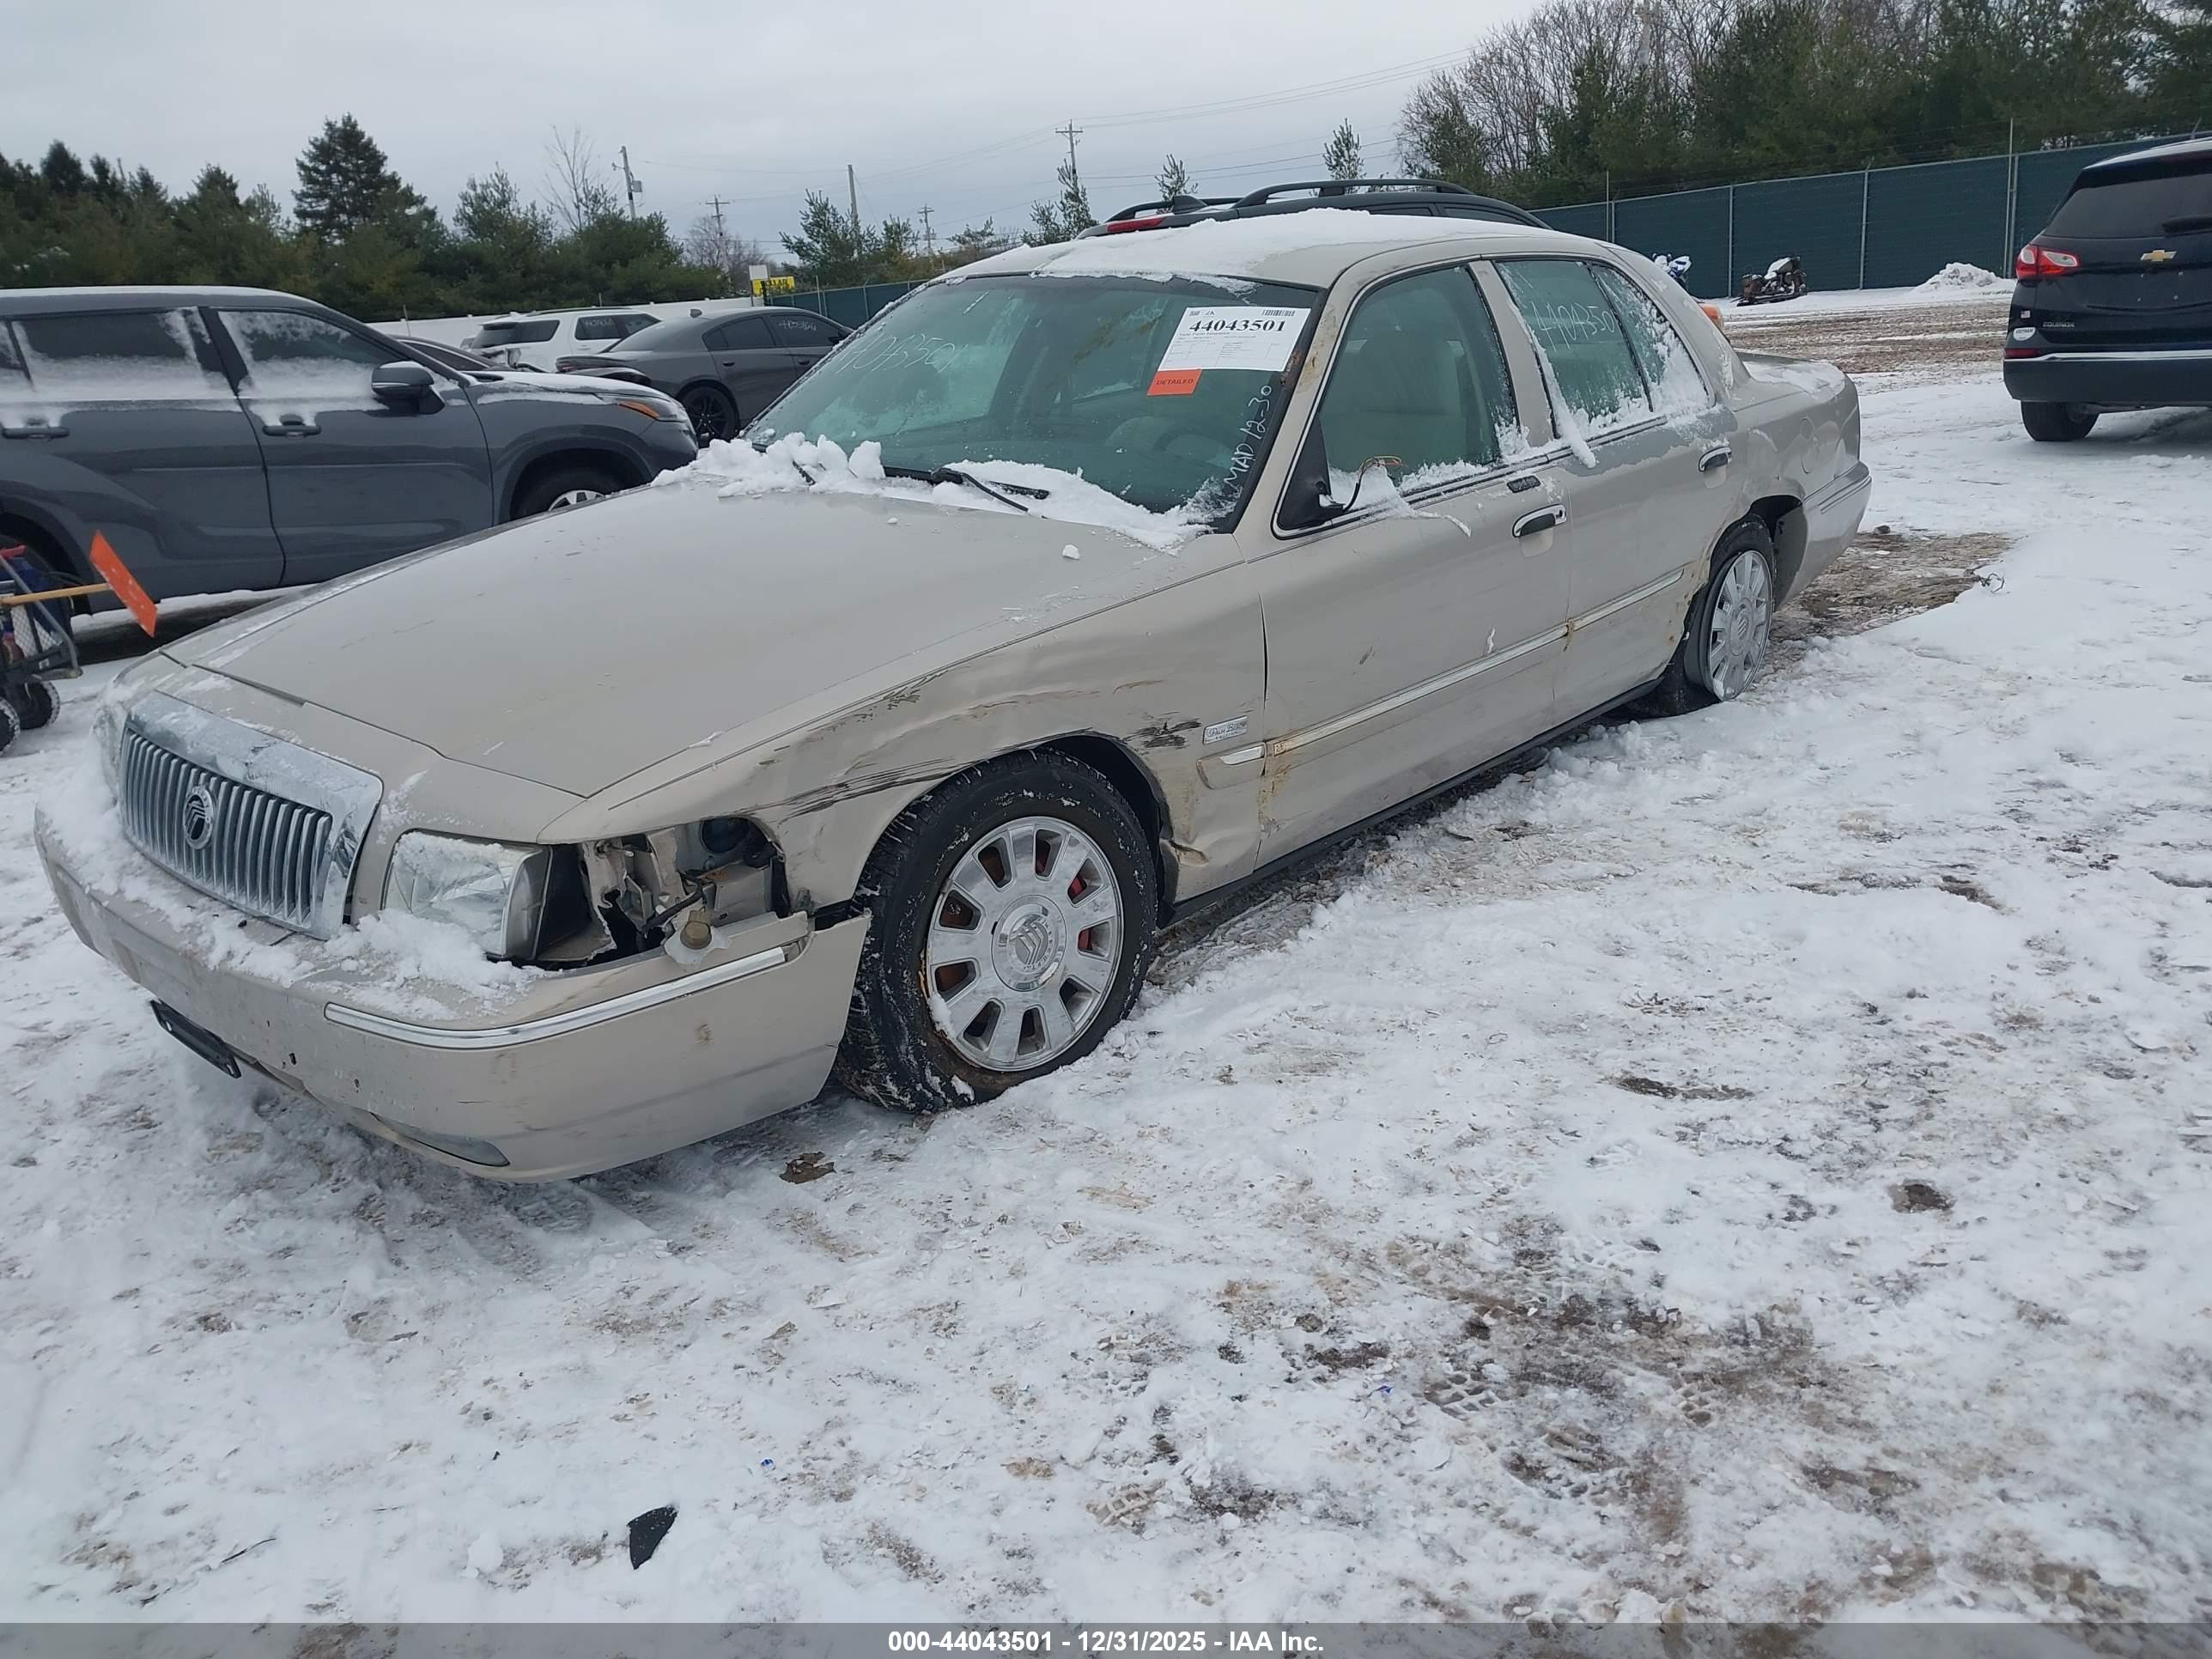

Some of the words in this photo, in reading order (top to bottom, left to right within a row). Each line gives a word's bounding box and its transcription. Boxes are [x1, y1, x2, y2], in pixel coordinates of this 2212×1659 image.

[1189, 319, 1285, 331] 44043501
[1239, 385, 1272, 440] 12-30
[1224, 443, 1255, 492] MAD
